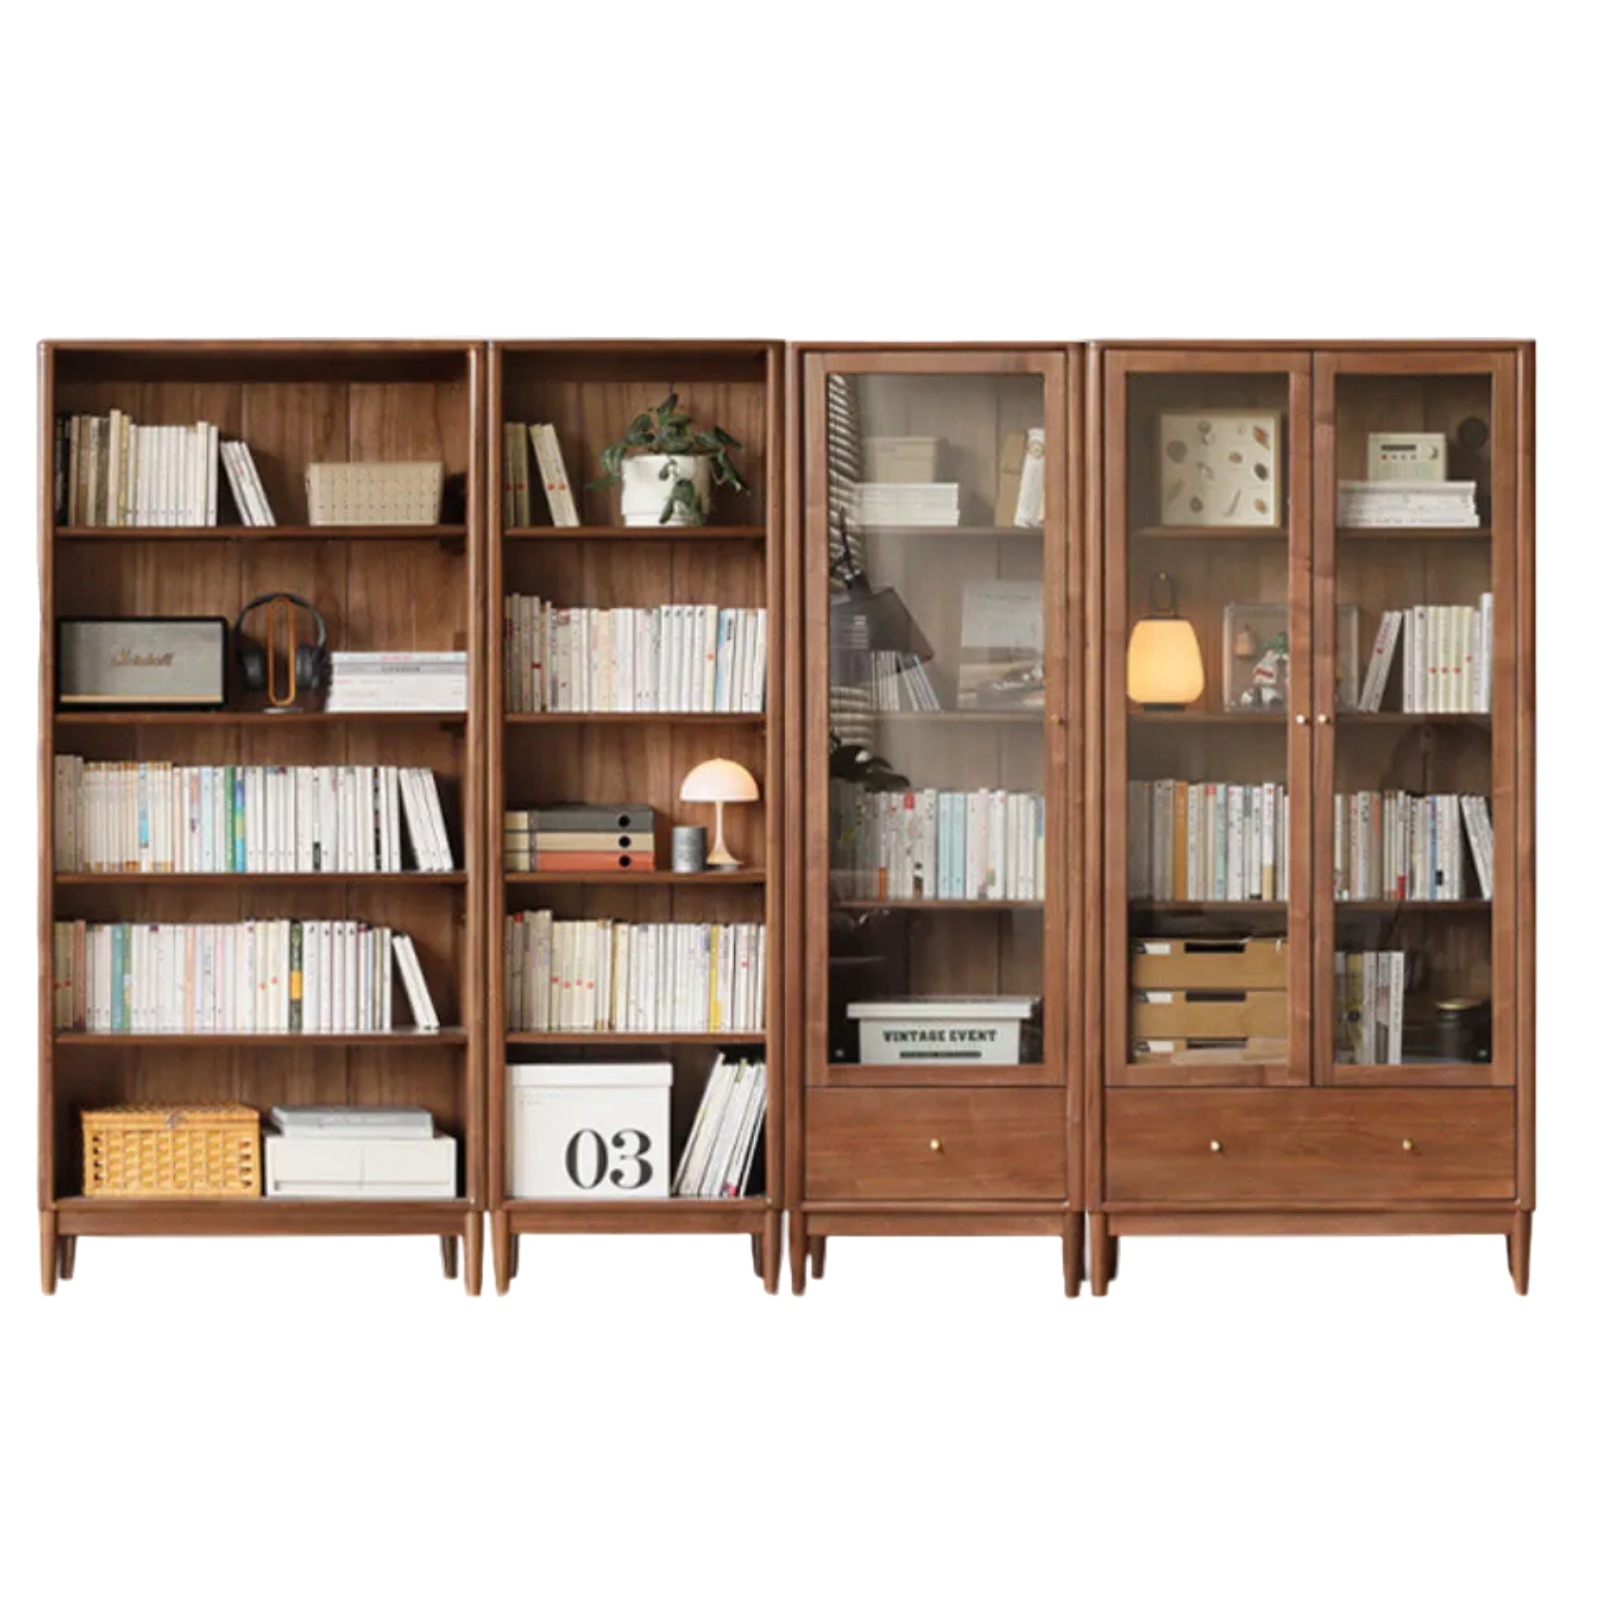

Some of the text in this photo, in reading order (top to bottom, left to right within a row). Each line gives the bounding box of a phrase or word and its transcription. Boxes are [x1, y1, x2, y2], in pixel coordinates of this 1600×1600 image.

[882, 1029, 997, 1042] VINTAGE EVENT
[565, 1128, 653, 1190] 03
